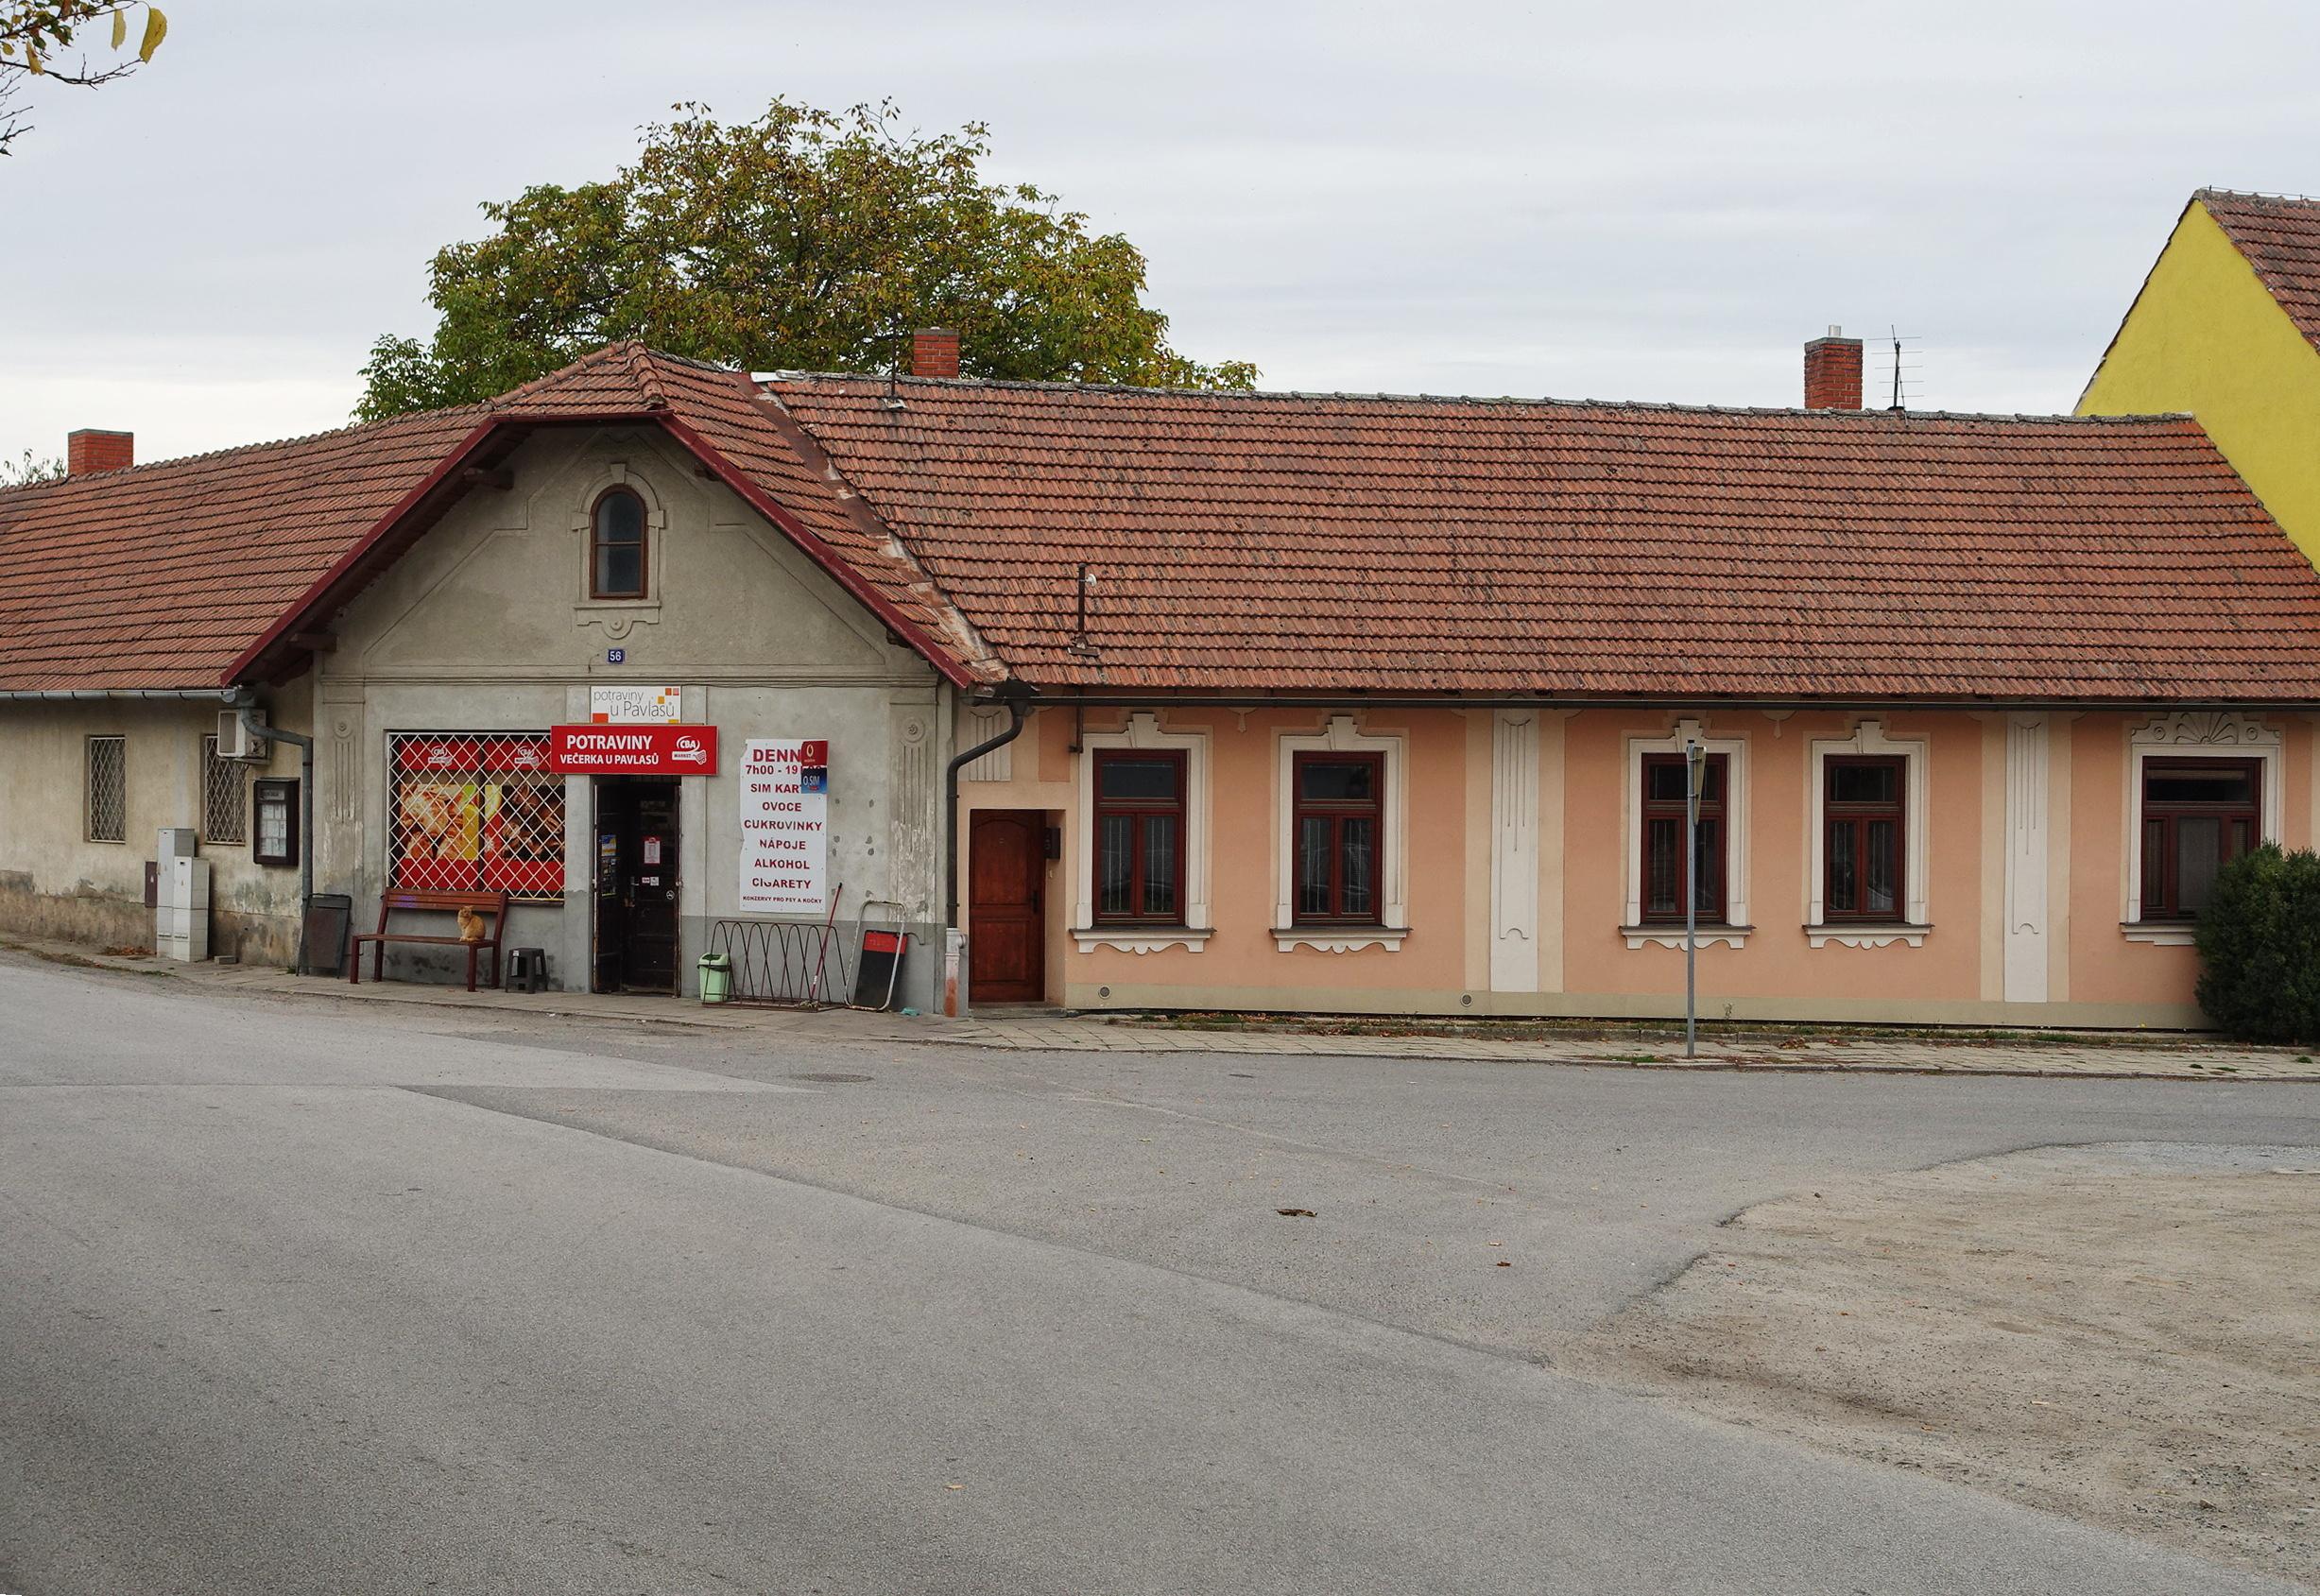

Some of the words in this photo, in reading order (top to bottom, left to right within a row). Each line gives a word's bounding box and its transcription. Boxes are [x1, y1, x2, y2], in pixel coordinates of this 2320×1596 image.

[610, 650, 622, 661] 56
[593, 689, 644, 705] potraviny
[610, 705, 619, 716] u
[624, 701, 675, 717] Pavlasů
[567, 735, 653, 749] POTRAVINY
[679, 740, 696, 749] CBA
[559, 752, 604, 764] VEČERKA
[606, 754, 612, 764] U
[614, 752, 659, 764] PAVLASŮ
[753, 748, 801, 763] DENN
[746, 764, 774, 775] 7h00
[750, 783, 771, 793] SIM
[775, 783, 801, 794] KAR
[762, 801, 801, 812] OVOCE
[744, 819, 822, 832] CUKROVINKY
[760, 837, 806, 849] NÁPOJE
[754, 858, 810, 869] ALKOHOL
